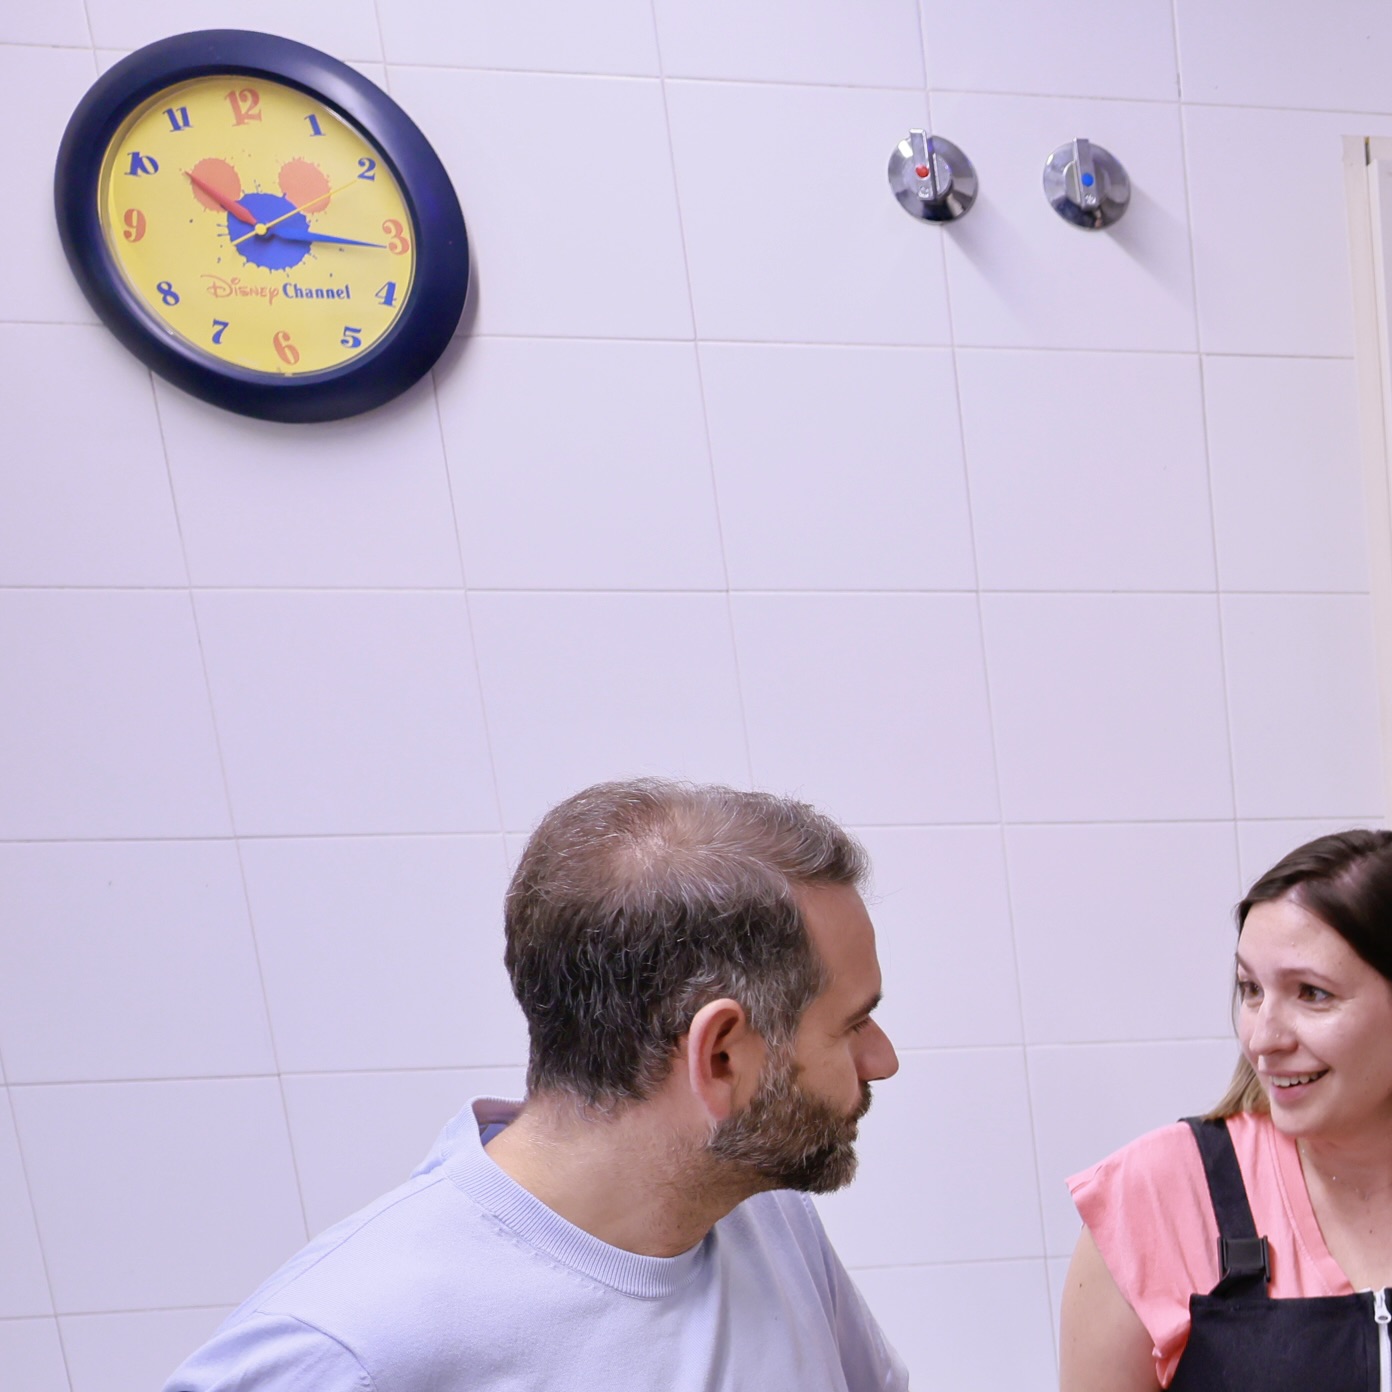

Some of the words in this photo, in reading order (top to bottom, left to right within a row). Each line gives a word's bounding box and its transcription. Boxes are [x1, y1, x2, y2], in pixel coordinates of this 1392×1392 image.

[163, 105, 195, 134] 11
[225, 88, 263, 129] 12
[303, 113, 327, 139] 1
[124, 151, 160, 179] 10
[356, 156, 377, 183] 2
[122, 208, 147, 243] 9
[382, 218, 411, 256] 3
[156, 281, 181, 308] 8
[282, 282, 352, 301] Channel
[374, 280, 399, 309] 4
[210, 317, 230, 346] 7
[339, 325, 363, 351] 5
[272, 330, 301, 367] 6
